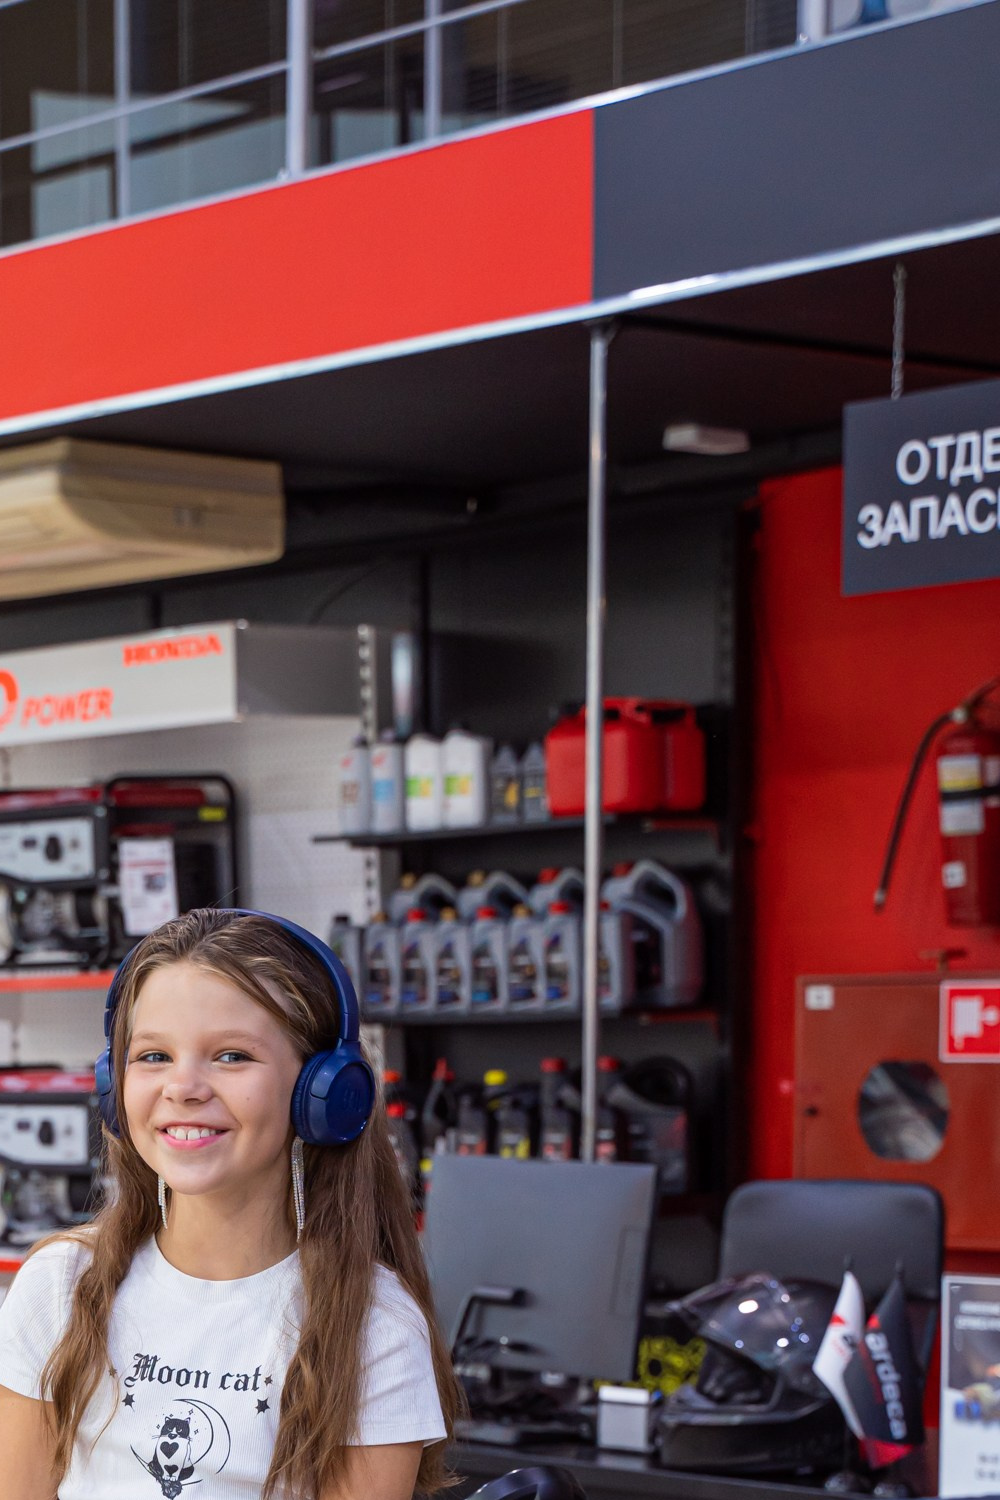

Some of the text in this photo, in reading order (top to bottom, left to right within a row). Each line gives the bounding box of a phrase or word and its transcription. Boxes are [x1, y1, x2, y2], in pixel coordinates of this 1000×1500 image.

[857, 487, 1000, 549] ЗАПАС
[122, 633, 223, 667] HONDA
[22, 688, 113, 728] POWER
[123, 1353, 262, 1392] Moon cat
[865, 1332, 907, 1440] ardeca
